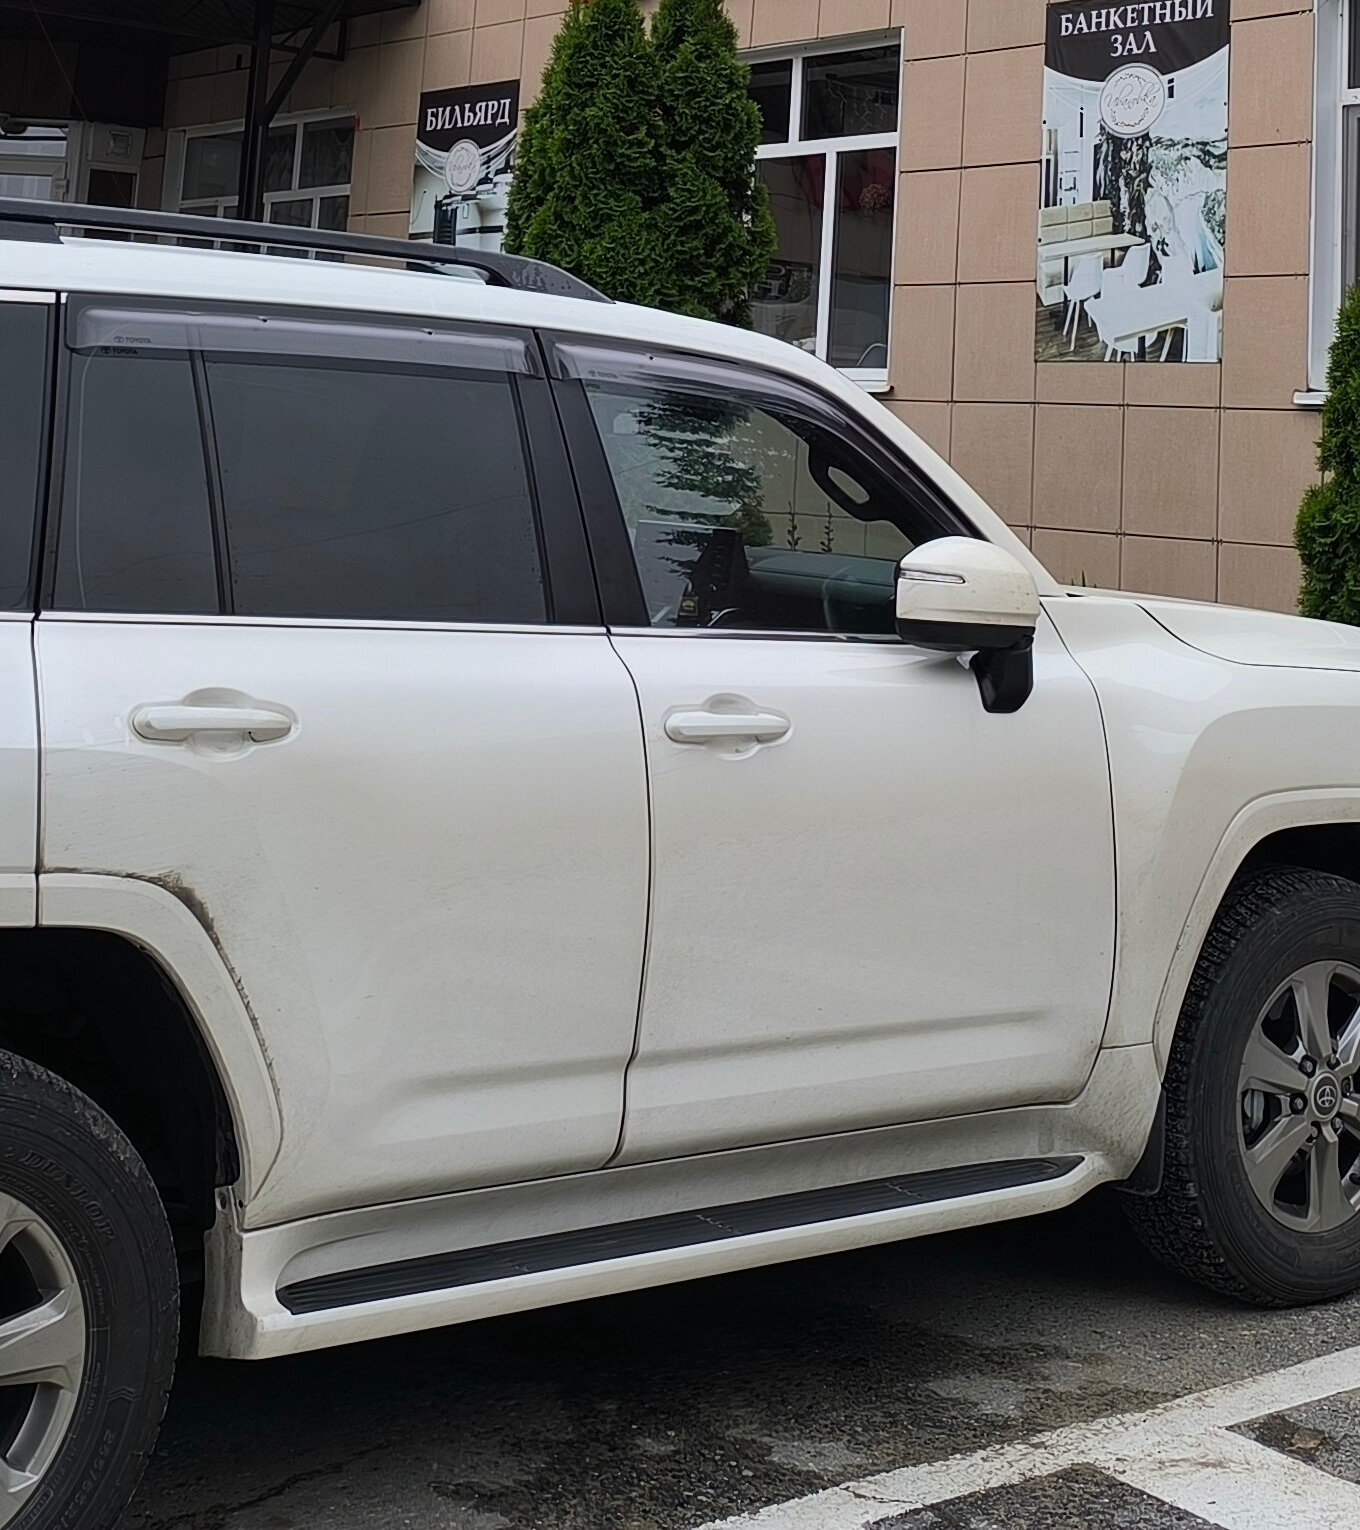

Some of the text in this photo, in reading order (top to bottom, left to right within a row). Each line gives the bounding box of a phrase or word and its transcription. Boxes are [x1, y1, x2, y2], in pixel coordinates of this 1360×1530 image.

[1109, 30, 1157, 57] ЗАЛ
[425, 98, 512, 132] БИЛЬЯРД
[19, 1149, 116, 1239] DUNLOP
